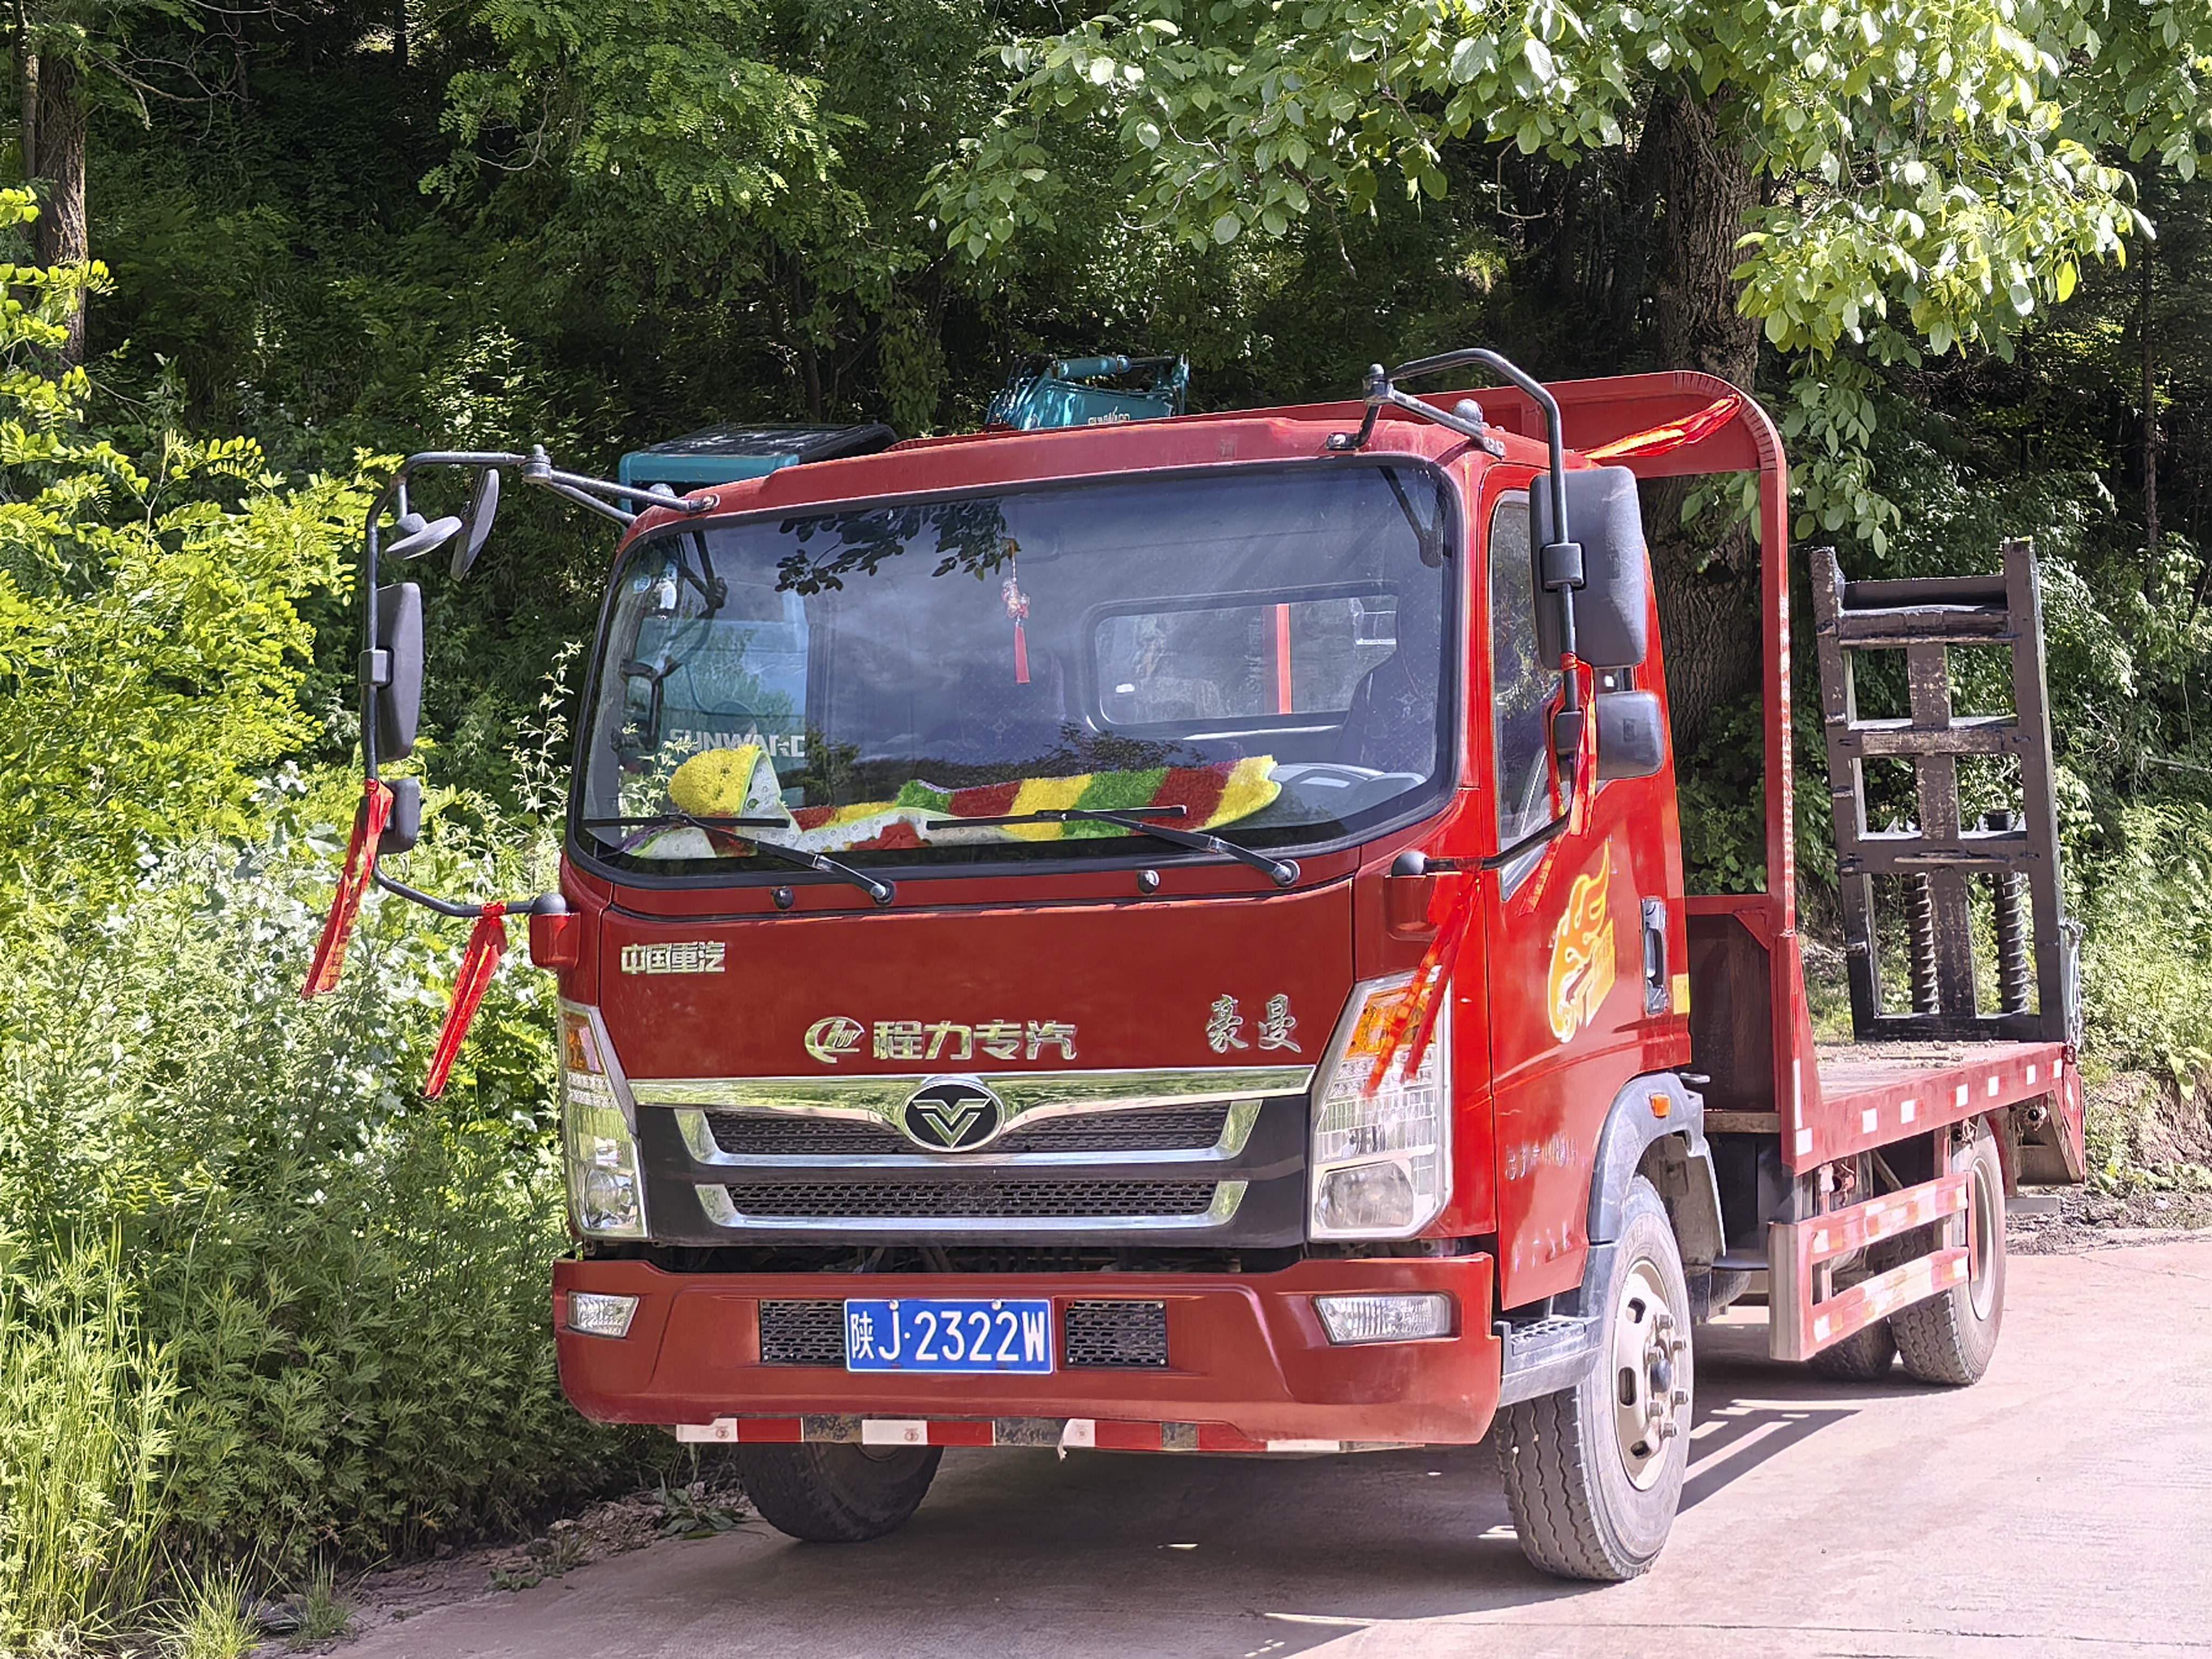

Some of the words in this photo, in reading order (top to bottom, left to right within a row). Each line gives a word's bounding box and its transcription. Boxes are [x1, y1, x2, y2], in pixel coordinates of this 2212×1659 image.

[621, 941, 725, 974] 中国重汽
[872, 1019, 1077, 1060] 程力专汽
[1206, 993, 1302, 1054] 豪曼
